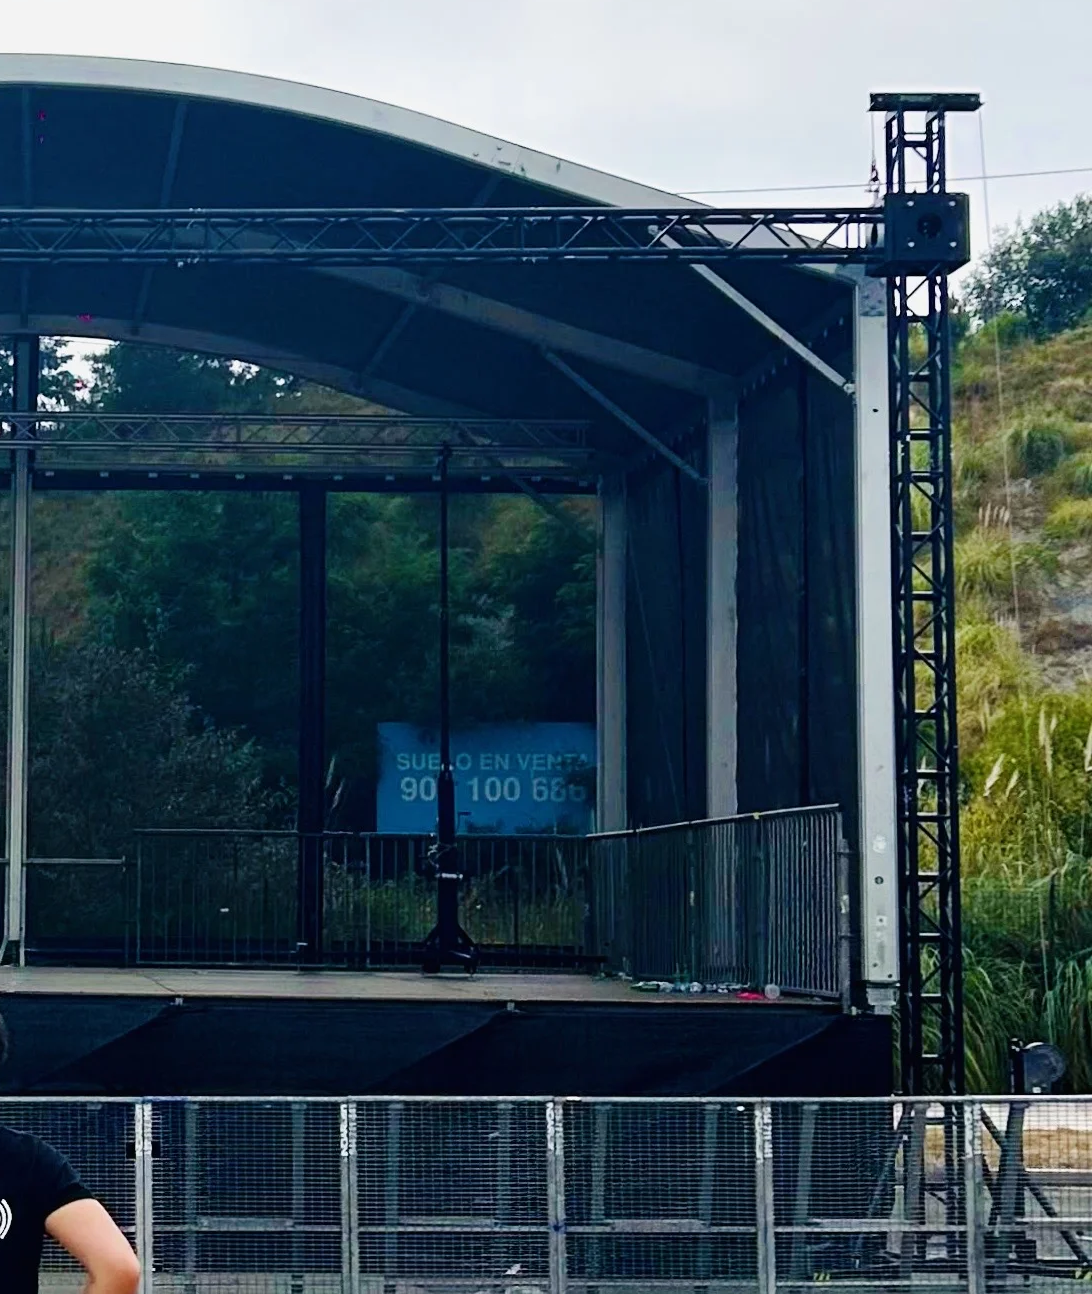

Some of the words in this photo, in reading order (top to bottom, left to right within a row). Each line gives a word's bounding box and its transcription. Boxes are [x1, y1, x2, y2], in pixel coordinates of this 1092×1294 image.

[480, 753, 510, 771] EN
[400, 776, 441, 802] 90
[468, 776, 521, 802] 100
